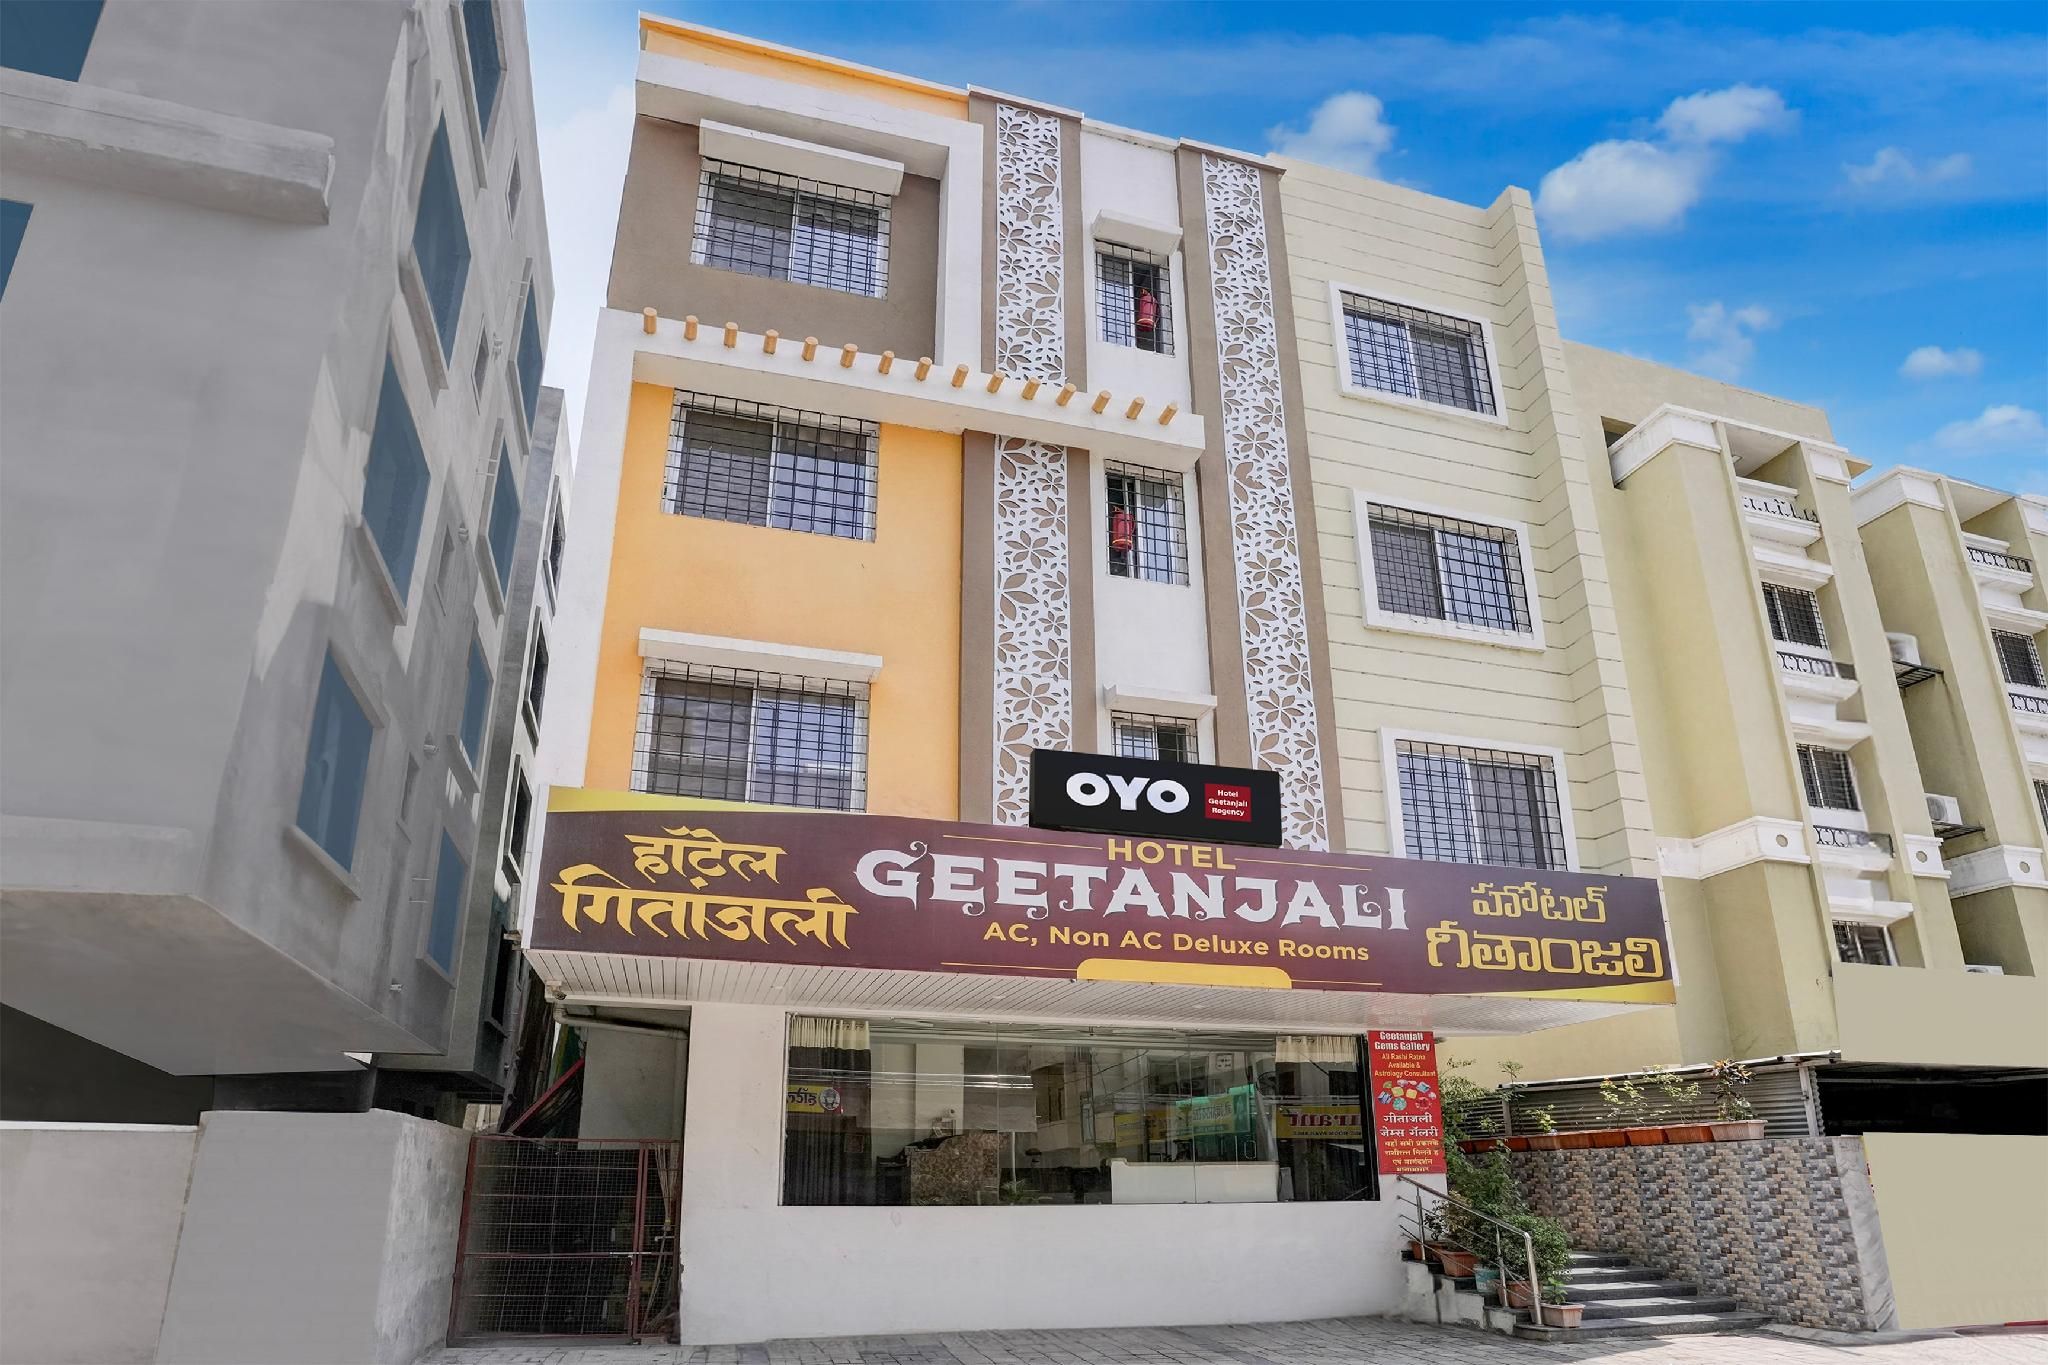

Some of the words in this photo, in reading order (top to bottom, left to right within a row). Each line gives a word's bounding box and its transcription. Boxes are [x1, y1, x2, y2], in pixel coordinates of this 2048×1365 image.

[1066, 772, 1190, 814] OYO
[1217, 789, 1239, 798] Hotel
[1208, 798, 1248, 808] Geetanjali
[1211, 807, 1245, 817] Regency
[1107, 839, 1236, 870] HOTEL
[853, 840, 1409, 931] GEETANJALI
[1470, 881, 1608, 924] హోటల్
[983, 921, 1038, 947] AC,
[1050, 926, 1110, 948] Non
[1119, 930, 1162, 951] AC
[1173, 933, 1270, 957] Deluxe
[1278, 938, 1369, 962] Rooms
[1425, 920, 1665, 978] గీతాంజలి
[1380, 1031, 1424, 1041] Geetanjali
[1374, 1041, 1399, 1050] Gems
[1399, 1041, 1431, 1051] Gallery
[1388, 1061, 1415, 1069] Available
[1374, 1070, 1403, 1078] Astrology
